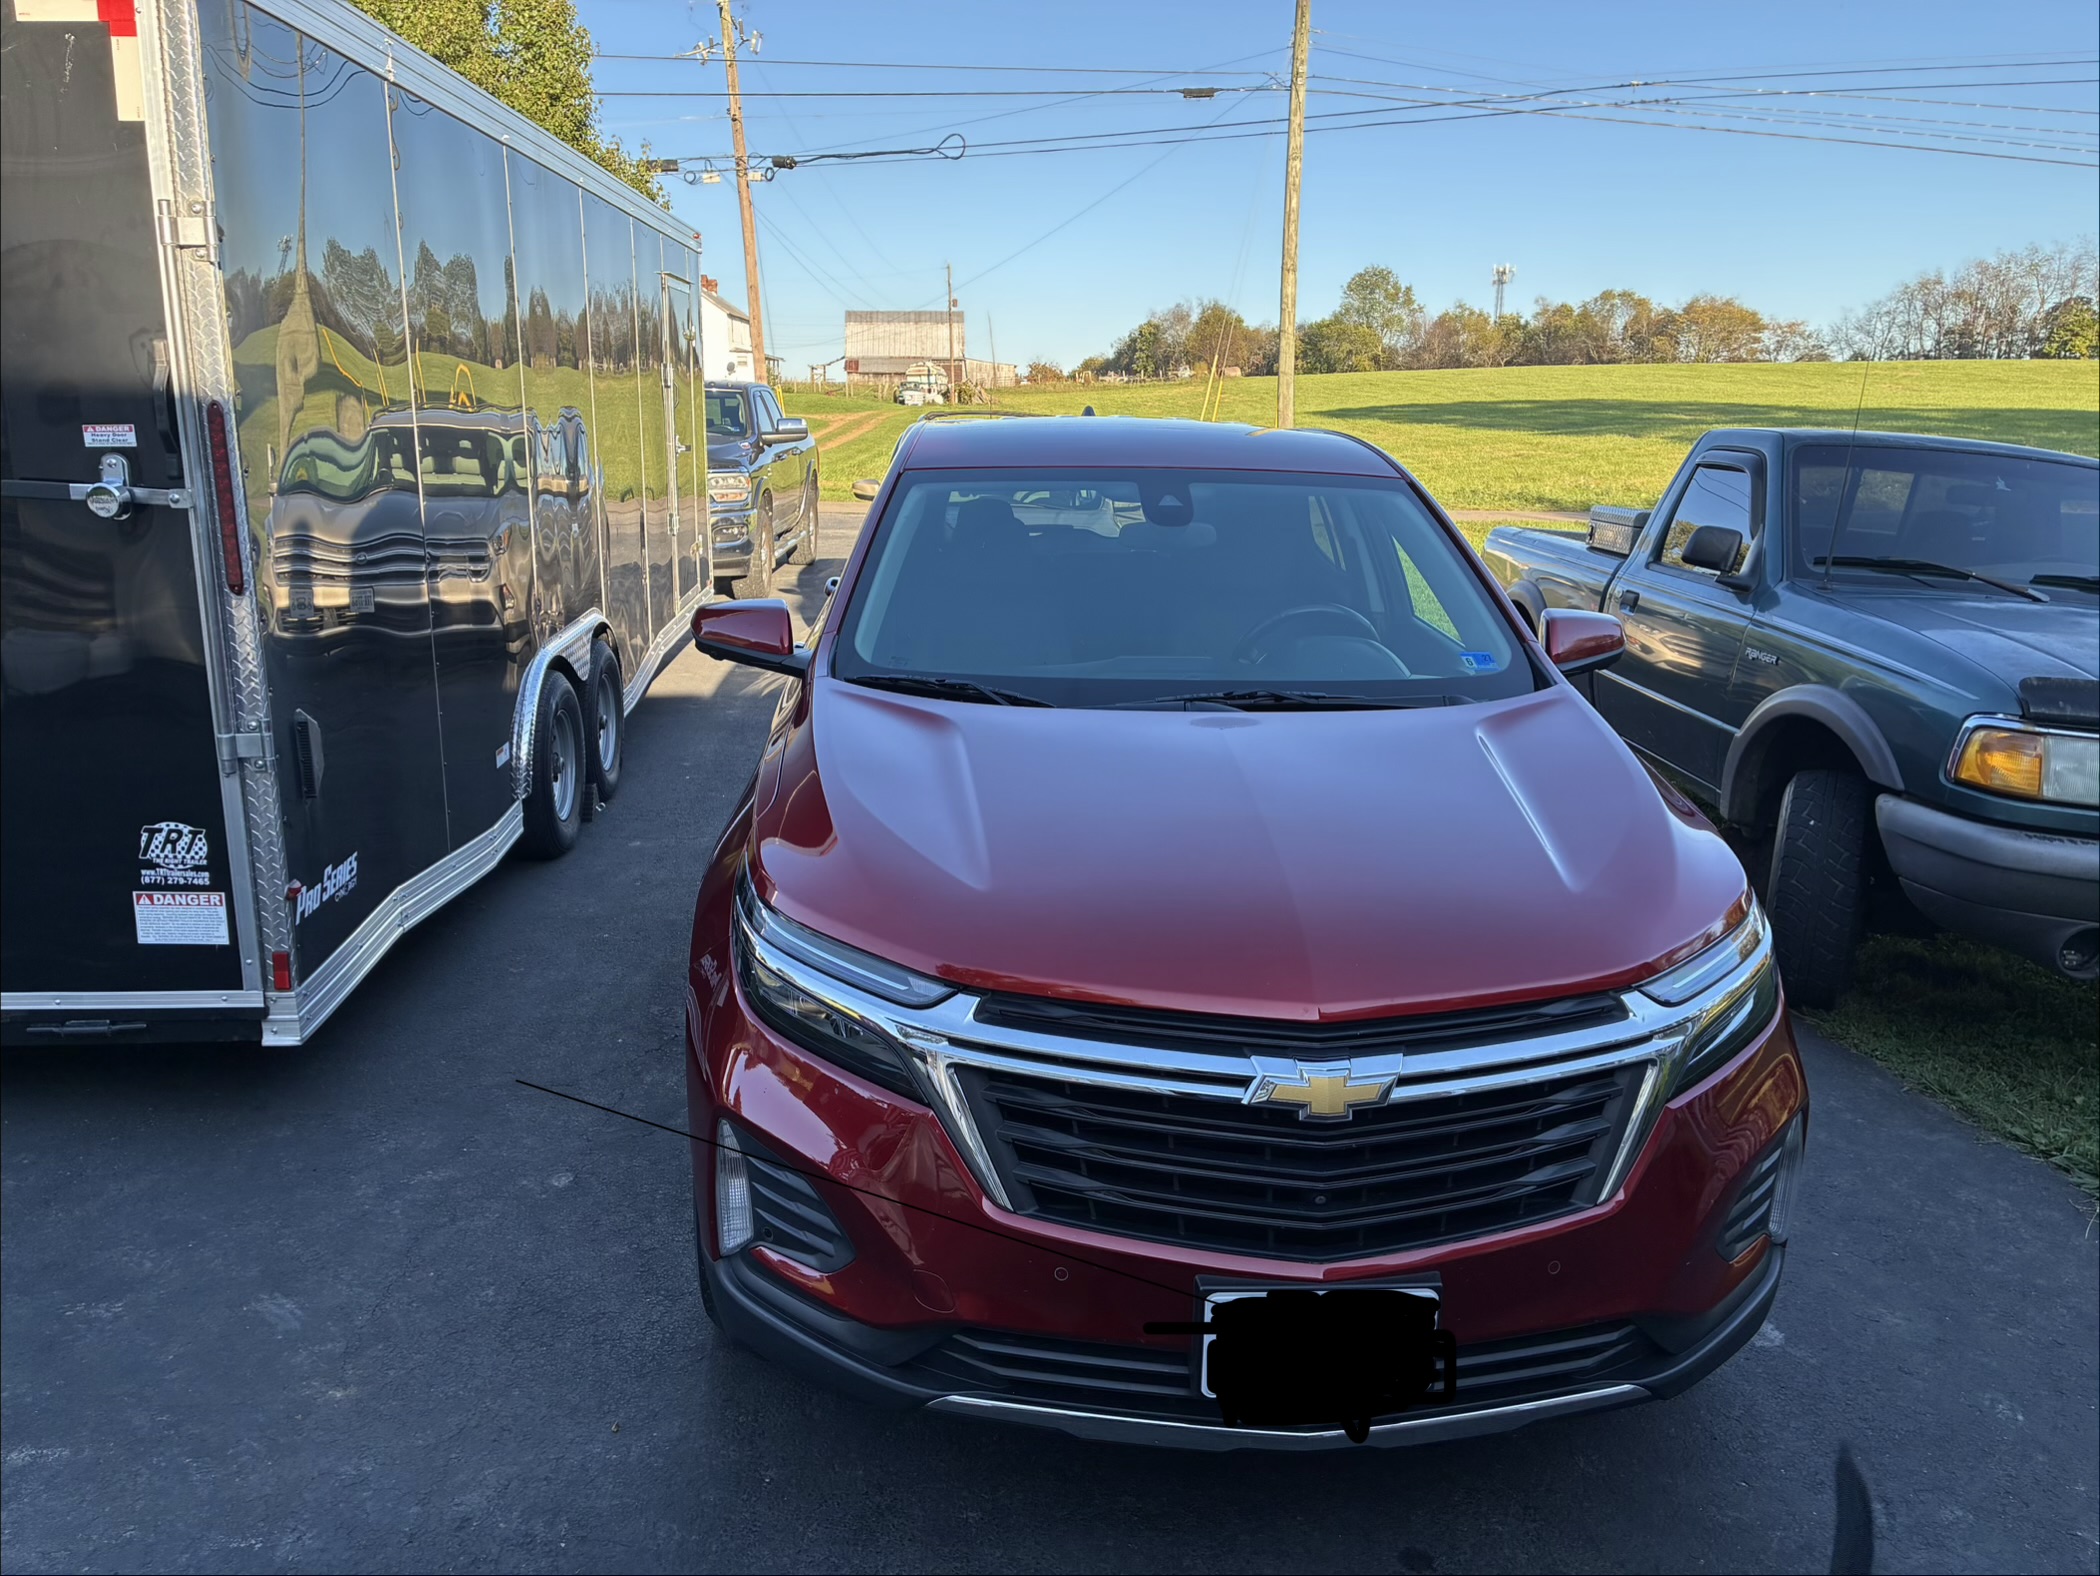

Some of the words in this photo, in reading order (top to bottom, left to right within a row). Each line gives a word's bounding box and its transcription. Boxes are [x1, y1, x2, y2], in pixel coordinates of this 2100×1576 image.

[1745, 647, 1777, 664] RANGER
[139, 825, 206, 859] TRT
[141, 876, 165, 885] (877)
[153, 894, 221, 906] DANGER
